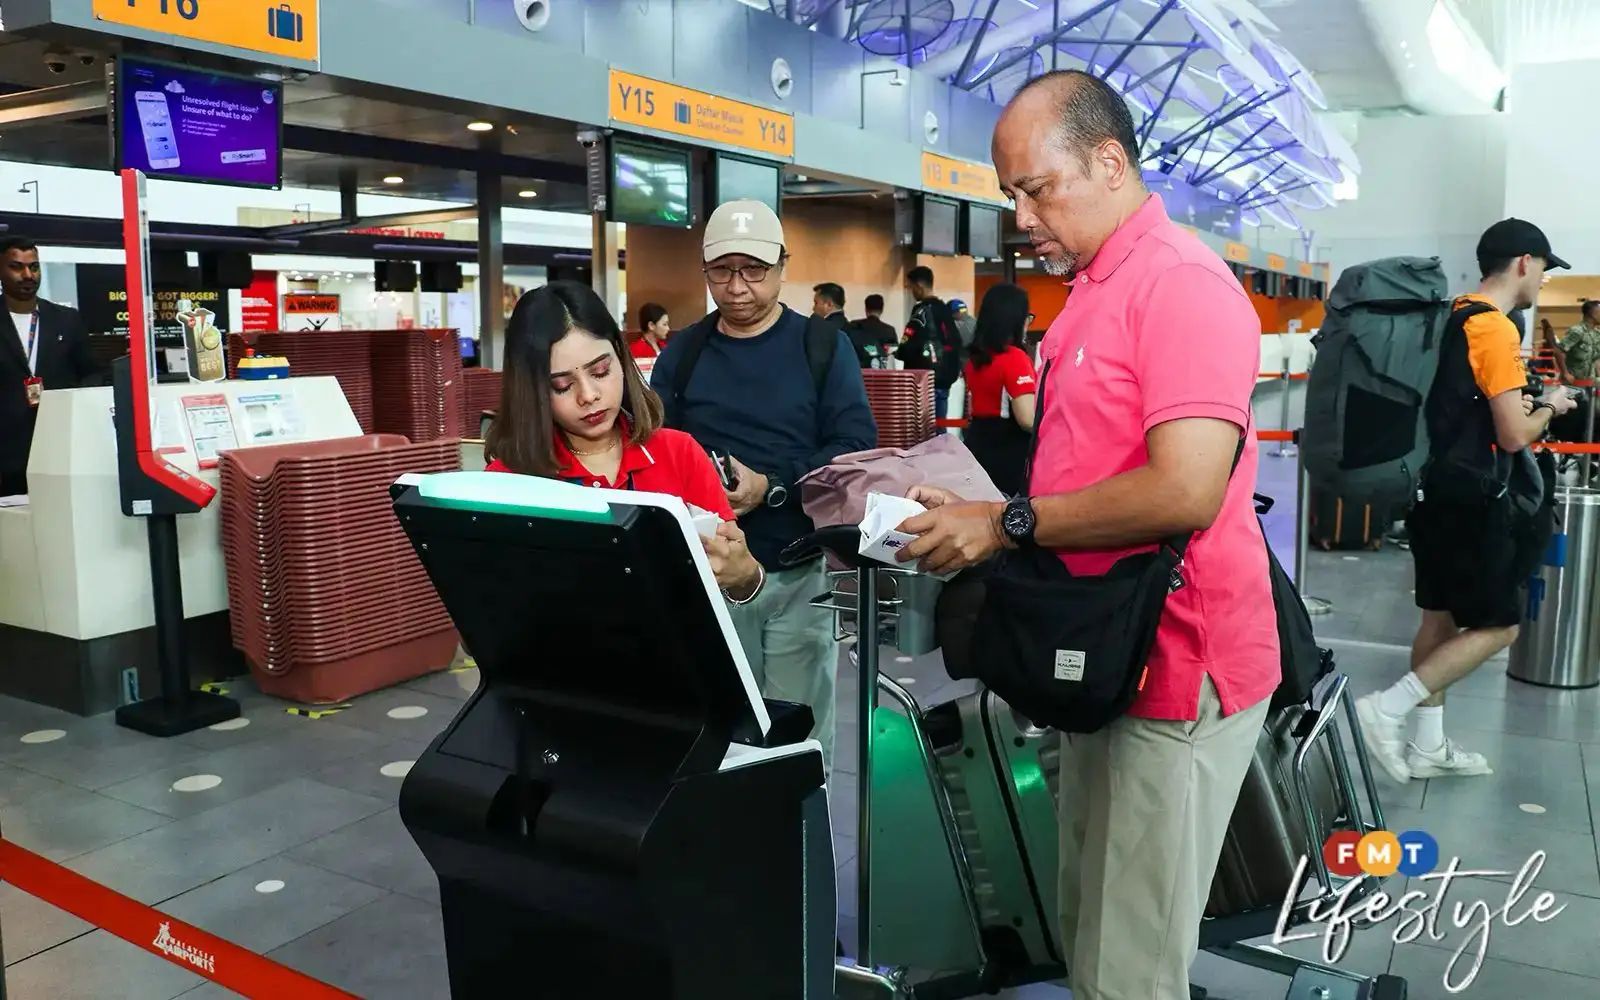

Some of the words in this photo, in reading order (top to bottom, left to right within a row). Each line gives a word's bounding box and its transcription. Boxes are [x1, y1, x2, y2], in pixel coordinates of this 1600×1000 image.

[182, 95, 220, 107] Unresolved
[221, 101, 239, 111] flight
[240, 104, 259, 113] issue?
[618, 83, 655, 116] Y15
[182, 105, 206, 115] Unsure
[207, 108, 215, 116] of
[216, 110, 232, 119] what
[759, 118, 786, 145] Y14
[731, 212, 753, 233] T
[109, 291, 127, 301] BIG
[157, 291, 177, 301] GOT
[180, 291, 219, 301] BIGGER!
[298, 301, 337, 310] WARNING
[165, 944, 215, 973] AIRPORTS
[169, 937, 215, 962] MALAYSIA
